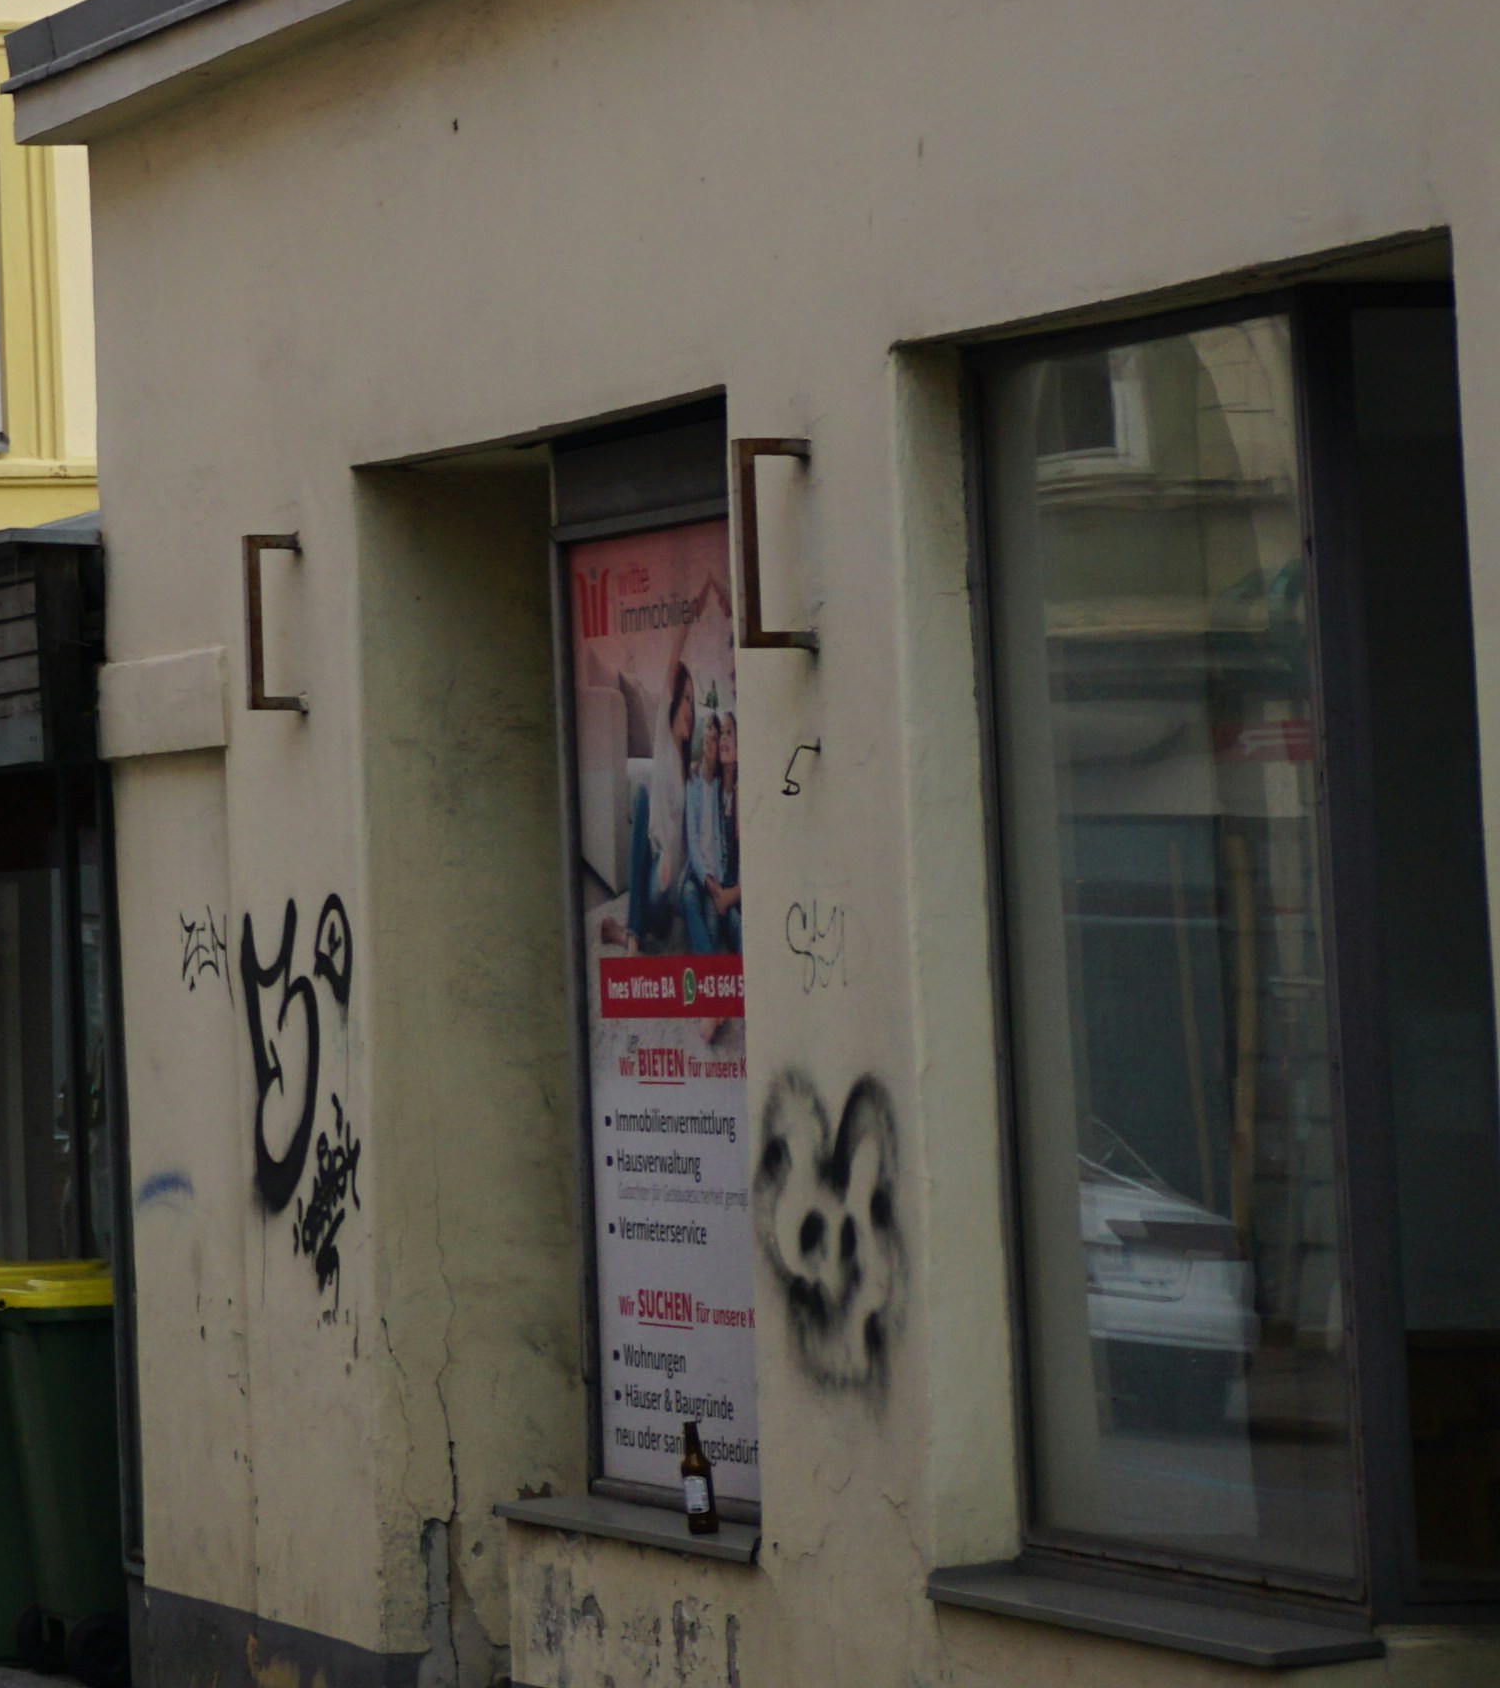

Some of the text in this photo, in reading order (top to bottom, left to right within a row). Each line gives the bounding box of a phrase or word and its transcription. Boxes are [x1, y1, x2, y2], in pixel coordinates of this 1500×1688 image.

[608, 977, 629, 999] Ines
[630, 976, 659, 999] Witte
[661, 976, 676, 999] BA
[697, 975, 716, 998] +43
[717, 975, 737, 998] 664
[619, 1055, 635, 1077] Wir
[638, 1048, 685, 1078] BIETEN
[688, 1055, 703, 1078] für
[704, 1062, 738, 1078] unsere
[615, 1108, 736, 1143] Immobilienvermittlung
[617, 1149, 702, 1183] Hausverwaltung
[619, 1216, 707, 1245] Vermieterservice
[618, 1295, 635, 1316] Wir
[638, 1289, 693, 1323] SUCHEN
[696, 1302, 711, 1324] für
[713, 1308, 747, 1328] unsere
[623, 1344, 687, 1379] Wohnungen
[625, 1385, 734, 1424] Häuser & Baugründe
[615, 1425, 635, 1448] neu
[638, 1426, 661, 1452] oder
